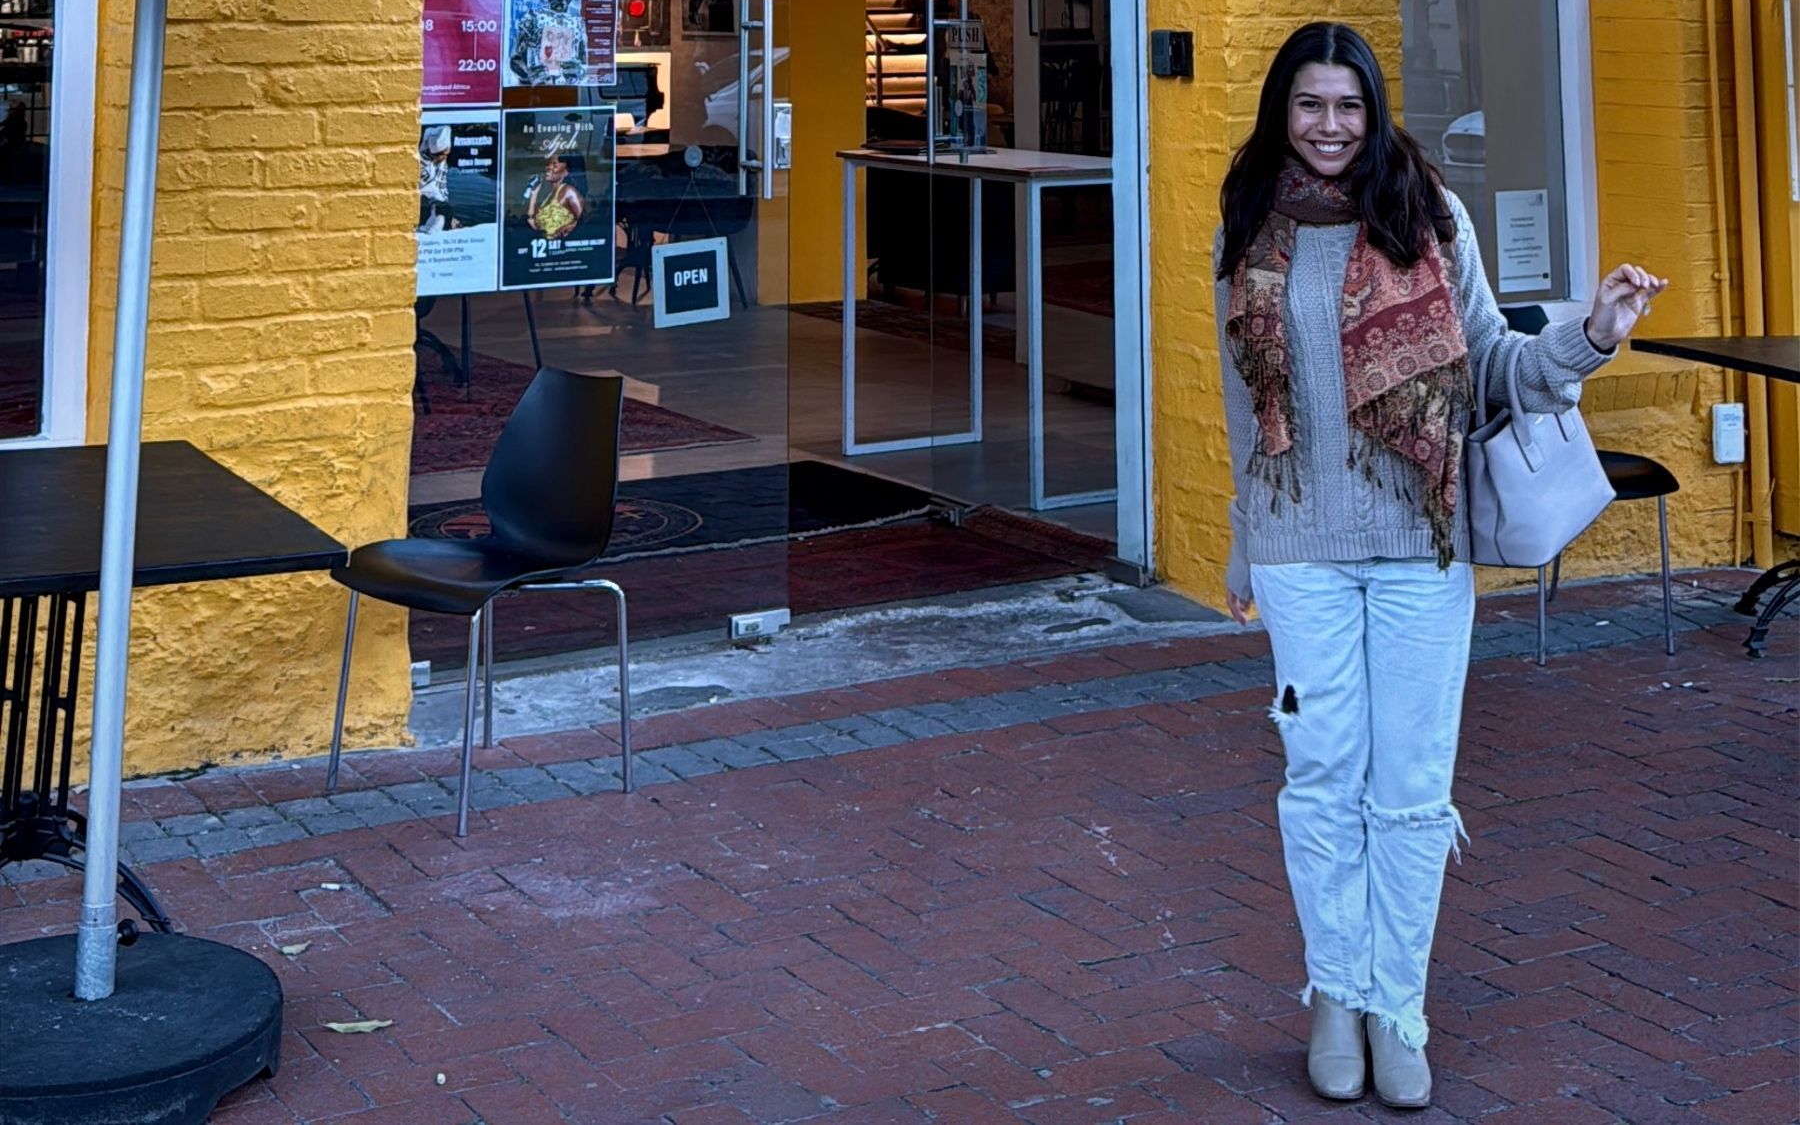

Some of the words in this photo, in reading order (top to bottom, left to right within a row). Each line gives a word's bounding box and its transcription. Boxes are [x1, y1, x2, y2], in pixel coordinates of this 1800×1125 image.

[461, 19, 498, 33] 15:00
[951, 27, 980, 43] PUSH
[457, 58, 497, 72] 22:00
[523, 124, 534, 134] An
[537, 123, 572, 134] Evening
[574, 122, 594, 133] With
[531, 238, 548, 259] 12
[548, 239, 562, 250] SAT
[674, 267, 708, 287] OPEN
